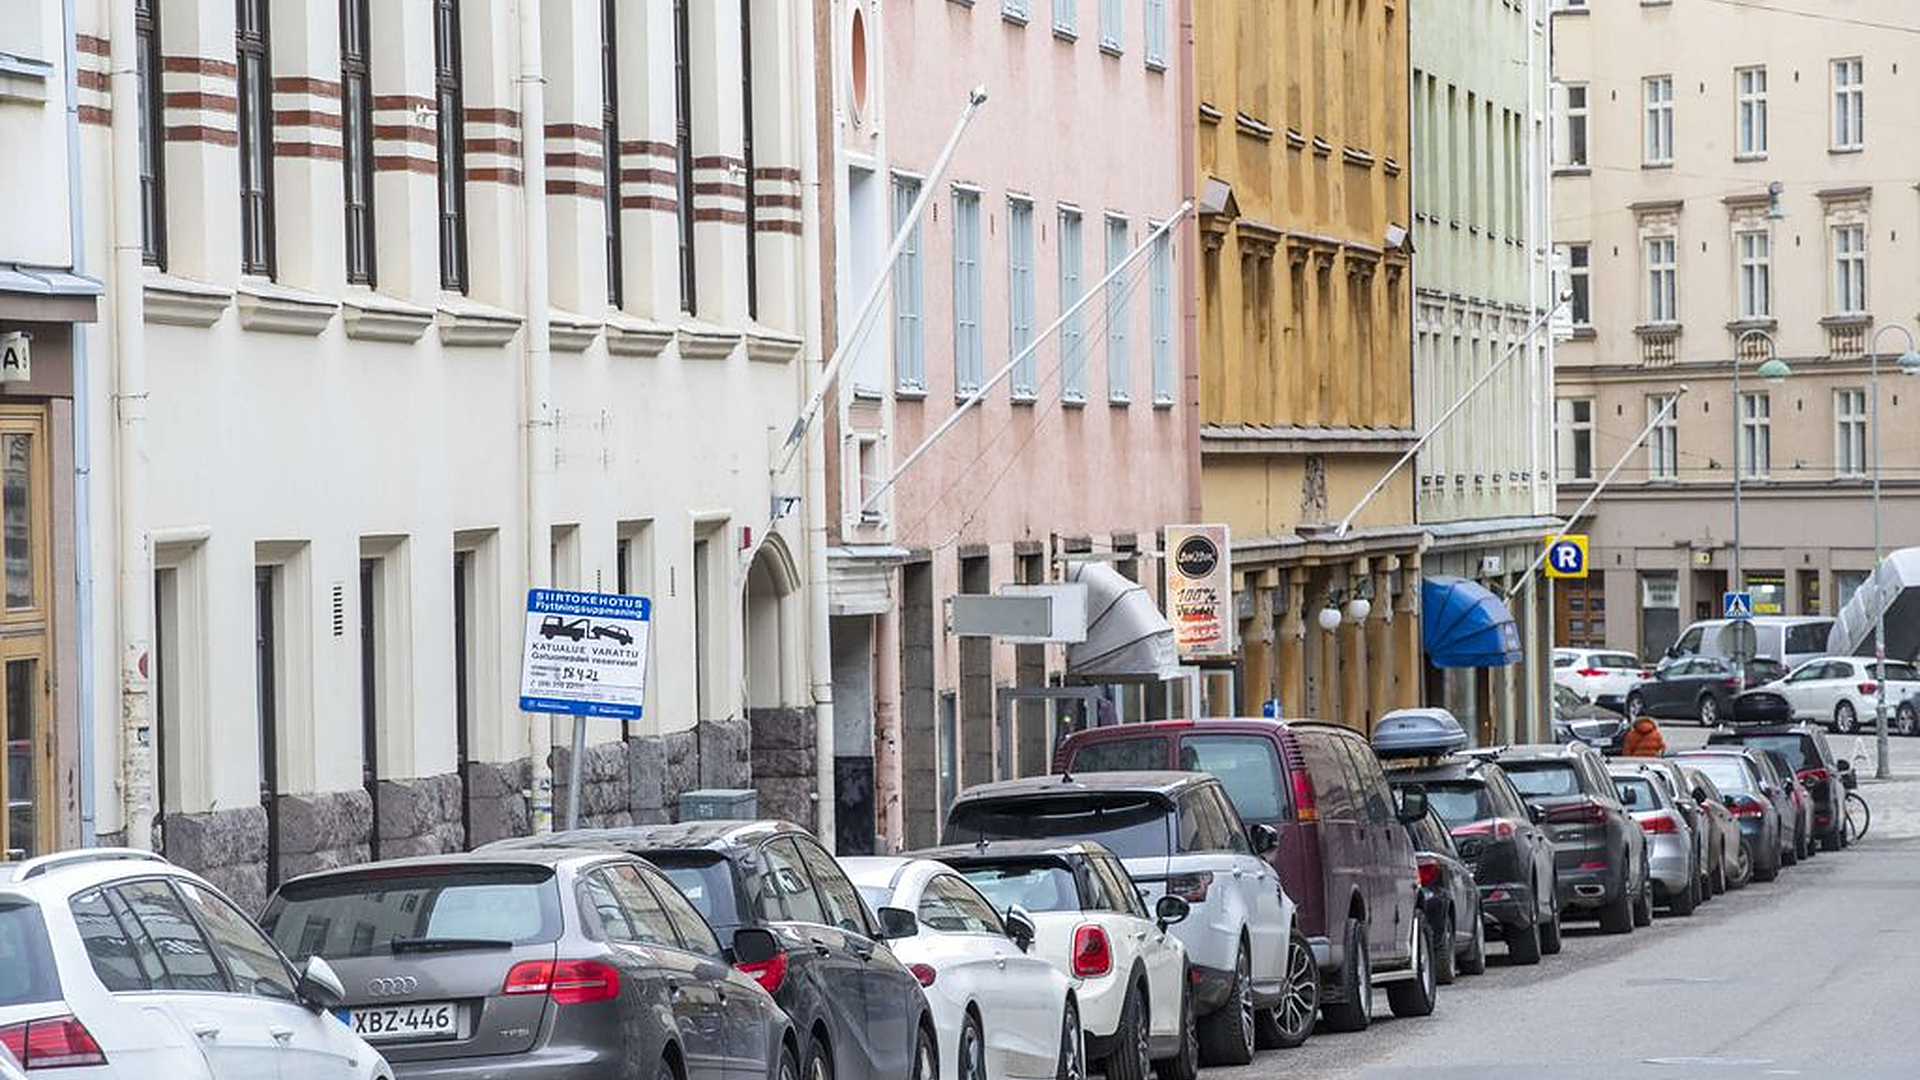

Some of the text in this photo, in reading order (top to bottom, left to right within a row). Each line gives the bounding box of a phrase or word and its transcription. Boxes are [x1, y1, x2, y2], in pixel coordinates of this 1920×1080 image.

[3, 347, 19, 369] A
[1557, 546, 1578, 568] R
[536, 592, 643, 608] SIIRTOKEHOTUS
[1177, 588, 1217, 604] 100%
[532, 642, 639, 658] KATUALUE VARATTU
[355, 1006, 450, 1034] XBZ-446
